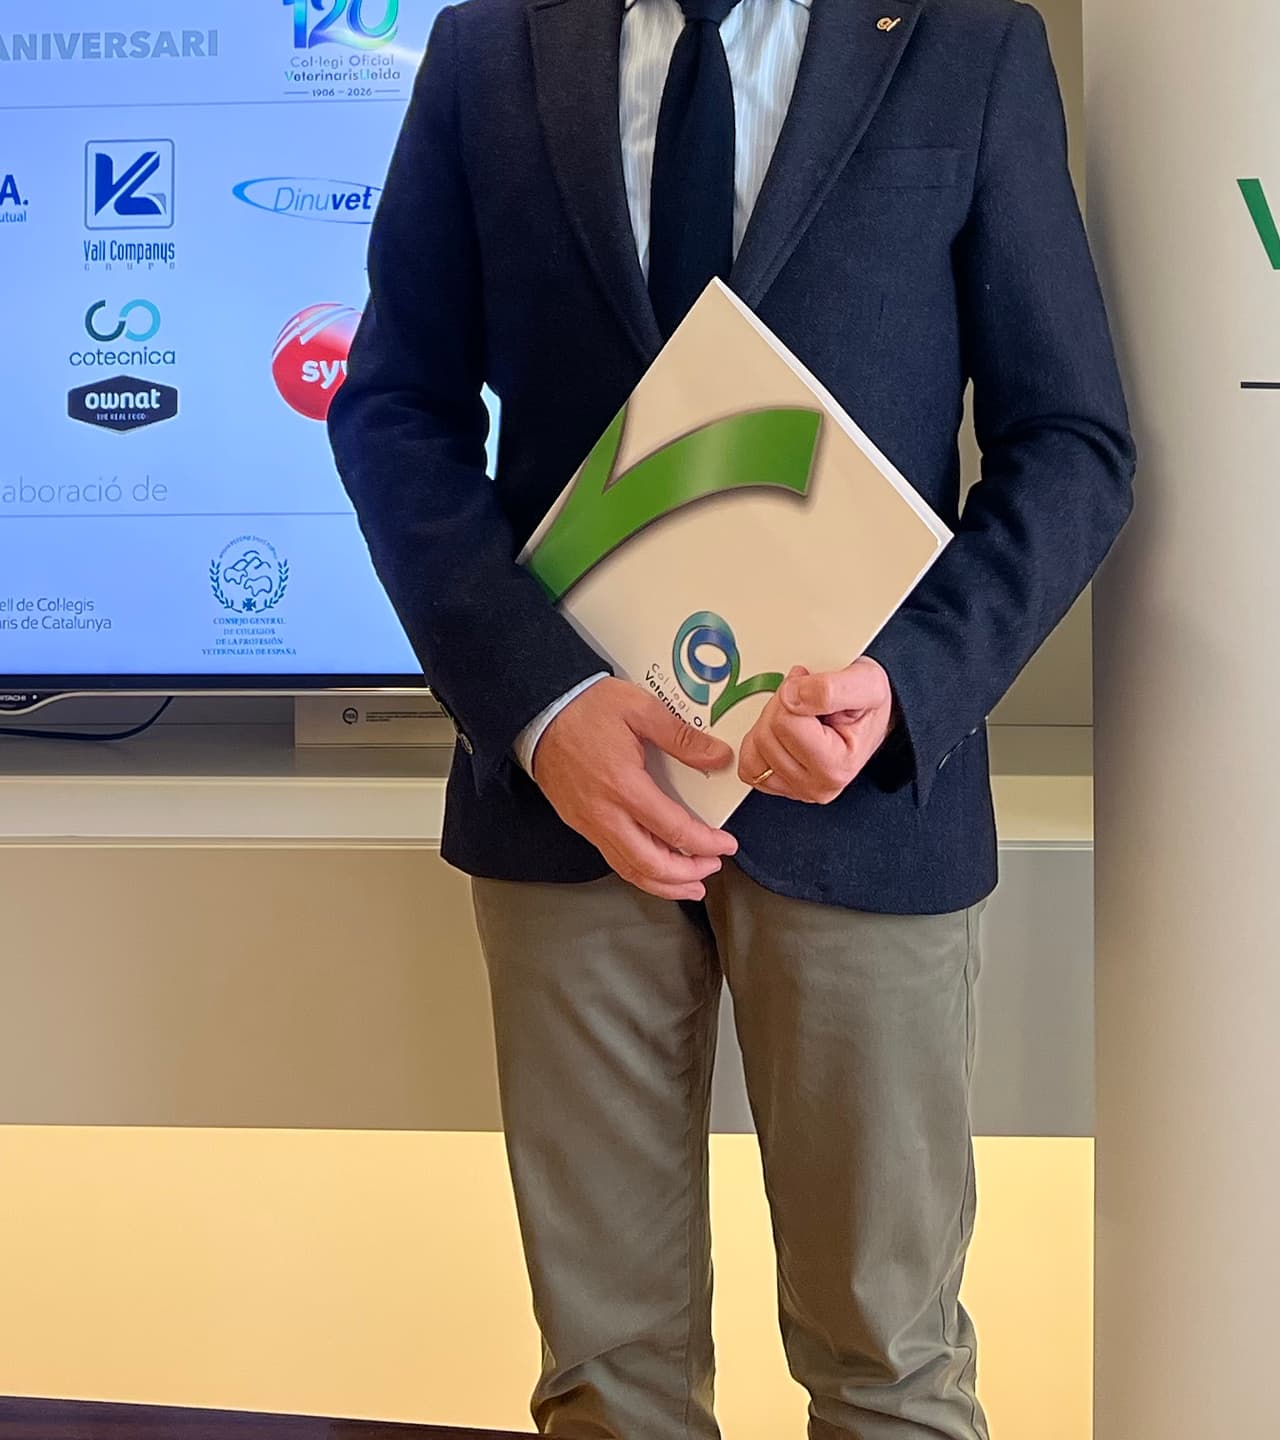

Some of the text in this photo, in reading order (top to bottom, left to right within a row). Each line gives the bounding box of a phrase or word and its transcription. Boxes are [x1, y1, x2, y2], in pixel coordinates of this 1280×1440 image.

[349, 54, 394, 66] Oficial
[347, 87, 372, 96] 2026
[273, 186, 372, 212] Dinuvet
[83, 239, 175, 264] Vall Companys
[69, 347, 176, 366] cotecnica
[84, 388, 161, 410] ownat
[132, 475, 168, 503] de
[16, 598, 34, 612] de
[21, 616, 38, 629] de
[42, 616, 112, 632] Catalunya
